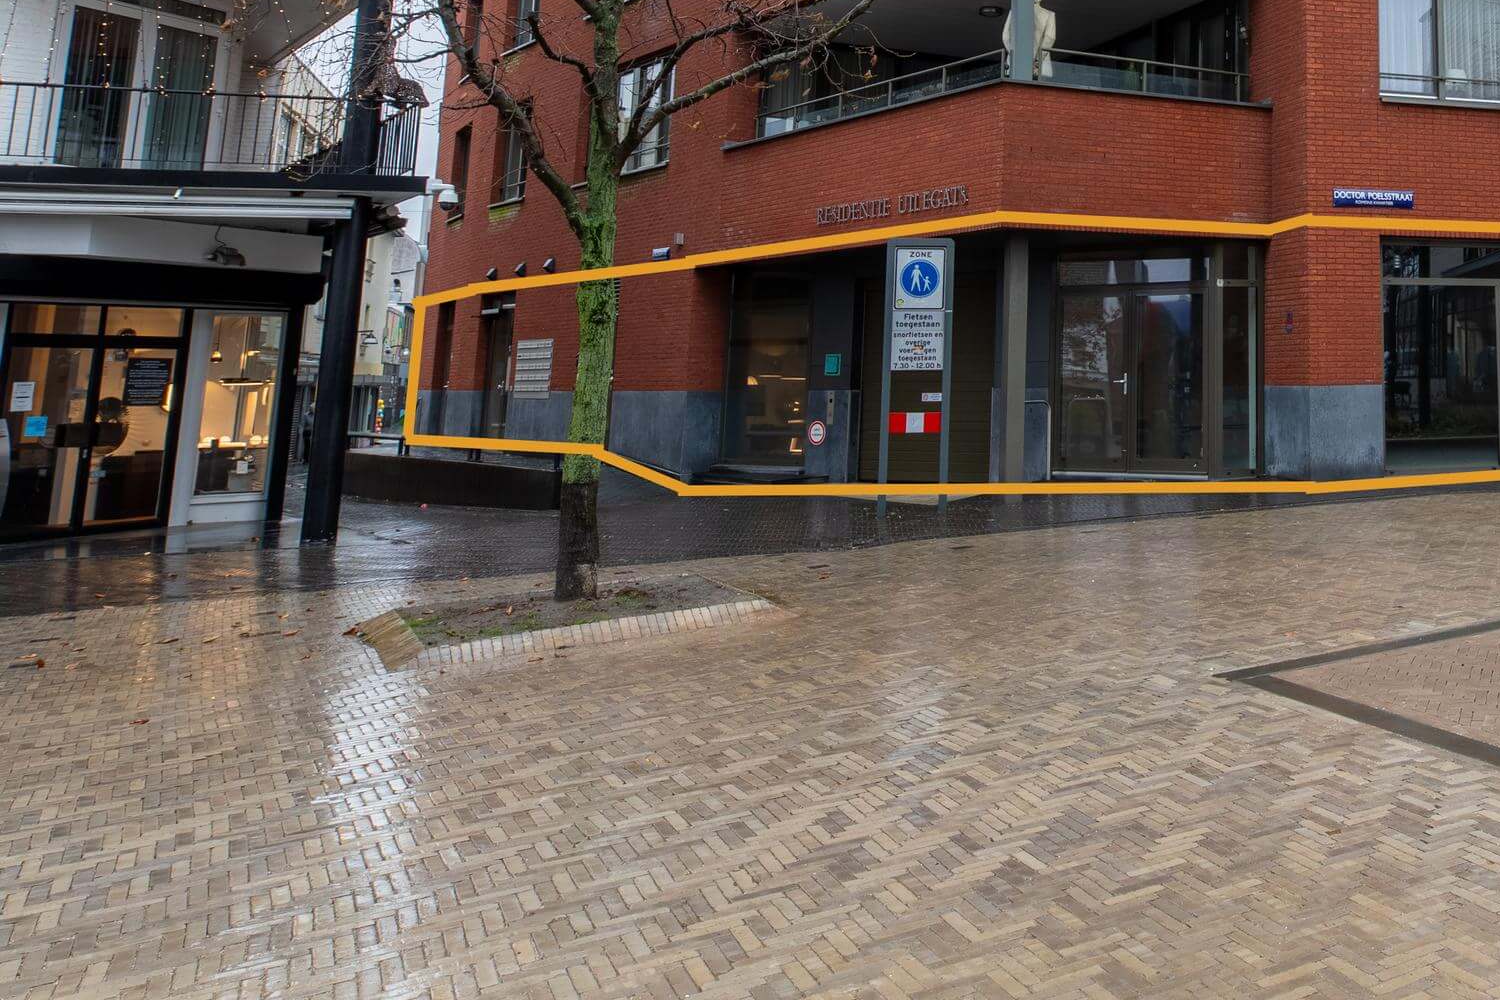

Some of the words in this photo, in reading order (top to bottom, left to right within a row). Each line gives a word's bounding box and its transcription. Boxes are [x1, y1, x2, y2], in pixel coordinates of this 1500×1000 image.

[1334, 190, 1366, 200] DOCTOR
[1367, 192, 1414, 201] POELSSTRAAT
[816, 197, 891, 225] RESIDENTIE
[904, 313, 934, 321] Fietsen
[896, 321, 941, 329] toegestaan
